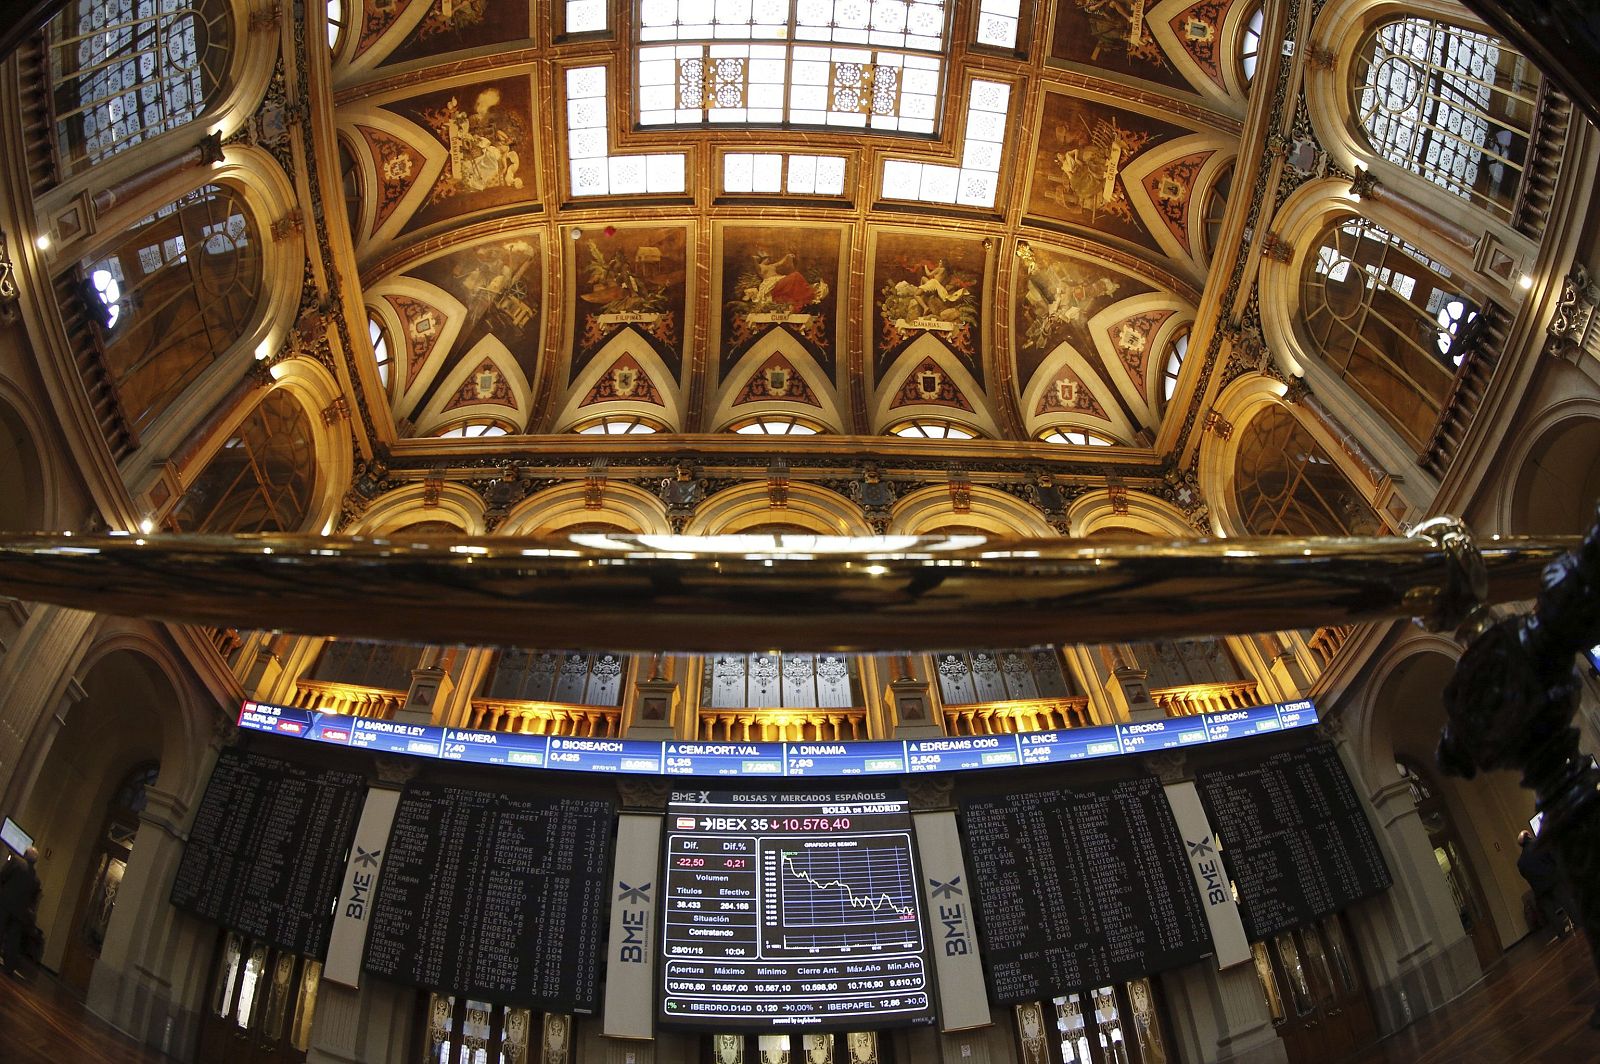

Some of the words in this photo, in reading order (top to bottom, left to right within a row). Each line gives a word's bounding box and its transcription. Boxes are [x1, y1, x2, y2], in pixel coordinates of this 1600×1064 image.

[1214, 712, 1248, 723] EUROPAC
[364, 721, 393, 732] BARON
[394, 724, 406, 734] DE
[407, 726, 426, 736] LEY
[1129, 722, 1164, 734] ERCROS
[456, 732, 497, 744] BAVIERA
[1030, 734, 1058, 744] ENCE
[445, 743, 466, 752] 7,40
[562, 740, 623, 752] BIOSEARCH
[920, 740, 972, 751] EDREAMS
[973, 738, 998, 748] ODIG
[678, 745, 760, 755] CEM.PORT.VAL
[800, 746, 846, 755] DINAMIA
[671, 792, 696, 802] BME
[733, 794, 767, 802] BOLSAS
[771, 794, 777, 802] Y
[781, 794, 830, 802] MERCADOS
[836, 792, 886, 801] ESPAÑOLES
[822, 806, 852, 814] BOLSA
[864, 804, 900, 813] MADRID
[712, 818, 748, 831] IBEX
[750, 818, 768, 831] 35
[783, 818, 850, 832] 10.576,40
[684, 841, 698, 850] Dif.
[723, 842, 746, 851] Dif.%
[676, 858, 704, 867] -22,50
[724, 860, 746, 868] -0,21
[696, 874, 729, 882] Volumen
[1200, 859, 1226, 906] BME
[346, 872, 370, 920] BME
[720, 888, 750, 896] Efectivo
[694, 914, 730, 922] Situación
[689, 928, 734, 936] Contratando
[940, 903, 967, 957] BME
[620, 910, 644, 964] BME
[672, 946, 704, 954] 28/01/15
[670, 966, 704, 974] Apertura
[714, 967, 745, 975] Máximo
[846, 964, 881, 973] Máx.Año
[690, 1003, 752, 1012] IBERDRO.D14D
[790, 1004, 814, 1012] 0,00%
[827, 1002, 875, 1011] IBERPAPEL
